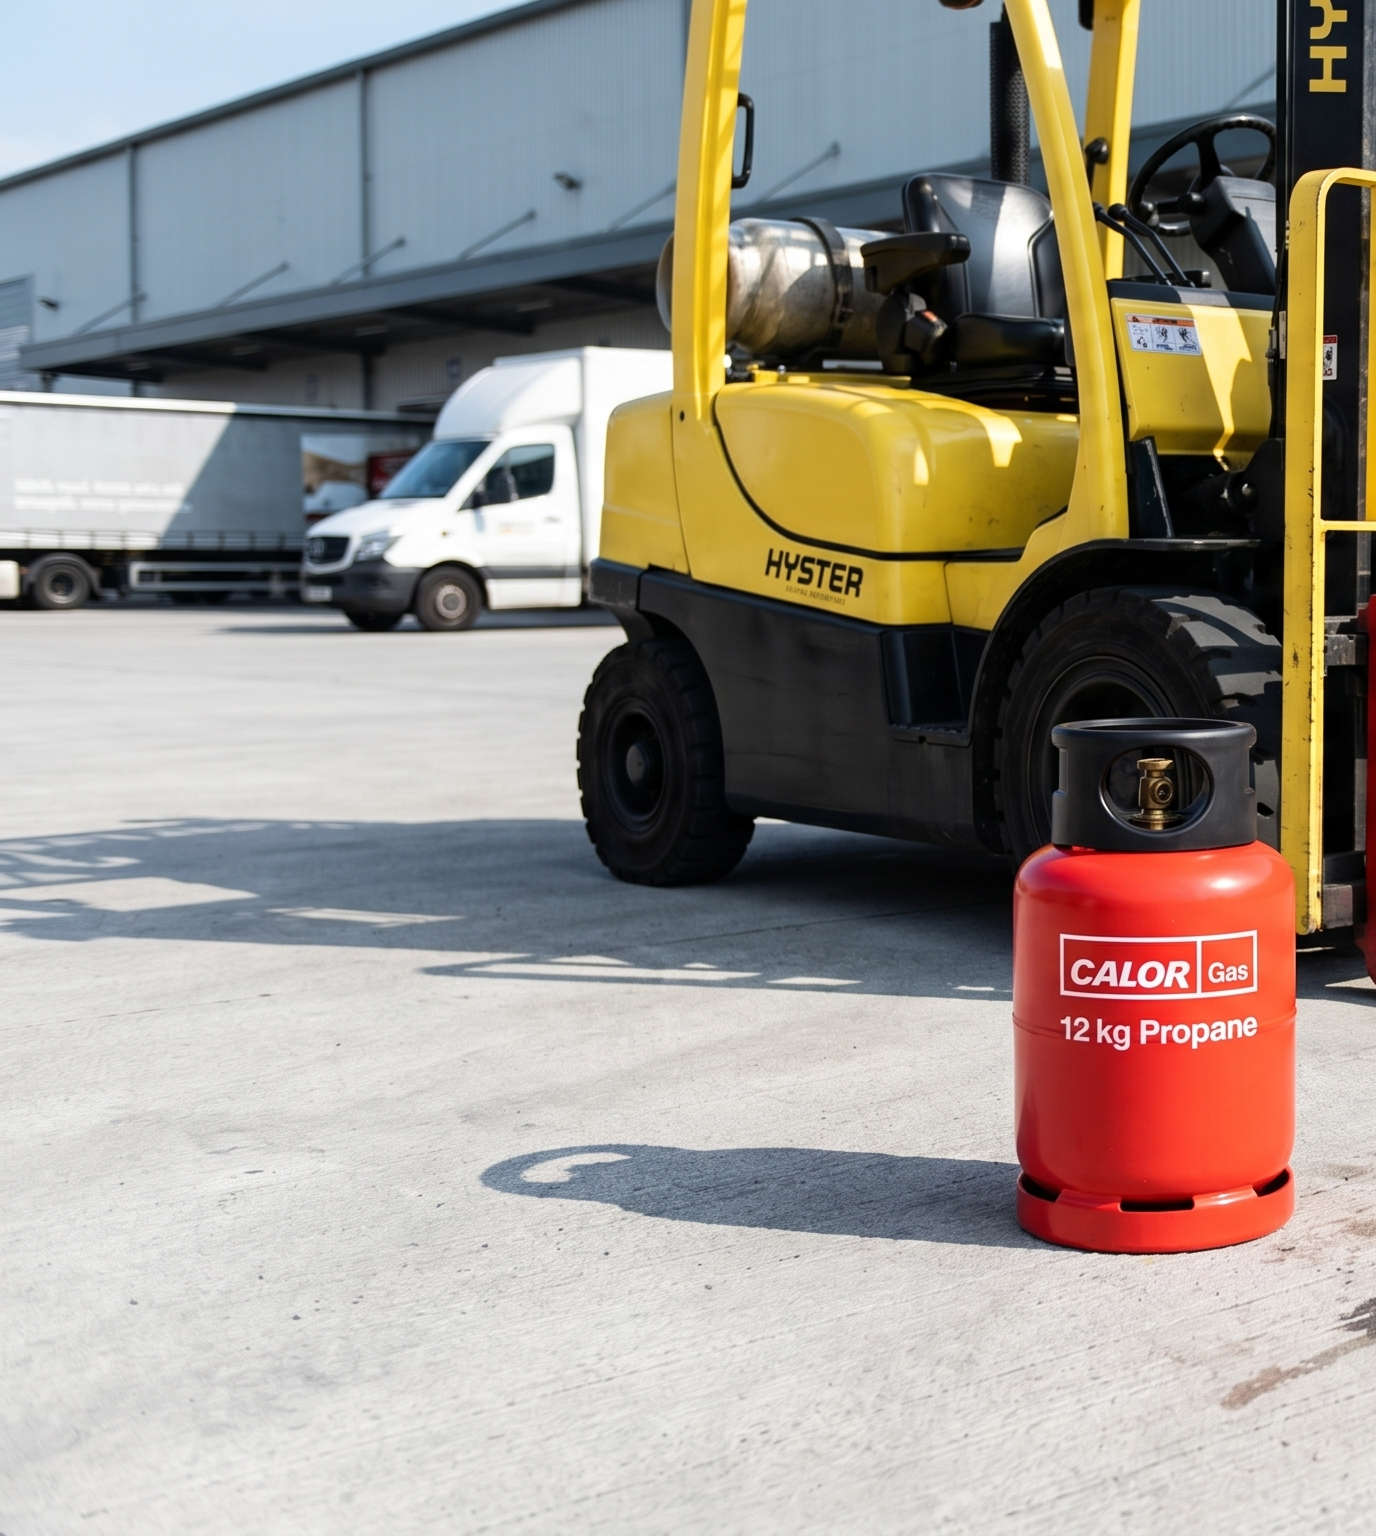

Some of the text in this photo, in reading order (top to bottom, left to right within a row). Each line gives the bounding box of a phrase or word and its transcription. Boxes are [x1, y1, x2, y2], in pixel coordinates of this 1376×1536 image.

[765, 548, 864, 598] HYSTER
[1070, 958, 1249, 989] CALOR Gas
[1060, 1016, 1258, 1051] 12 kg Propane
